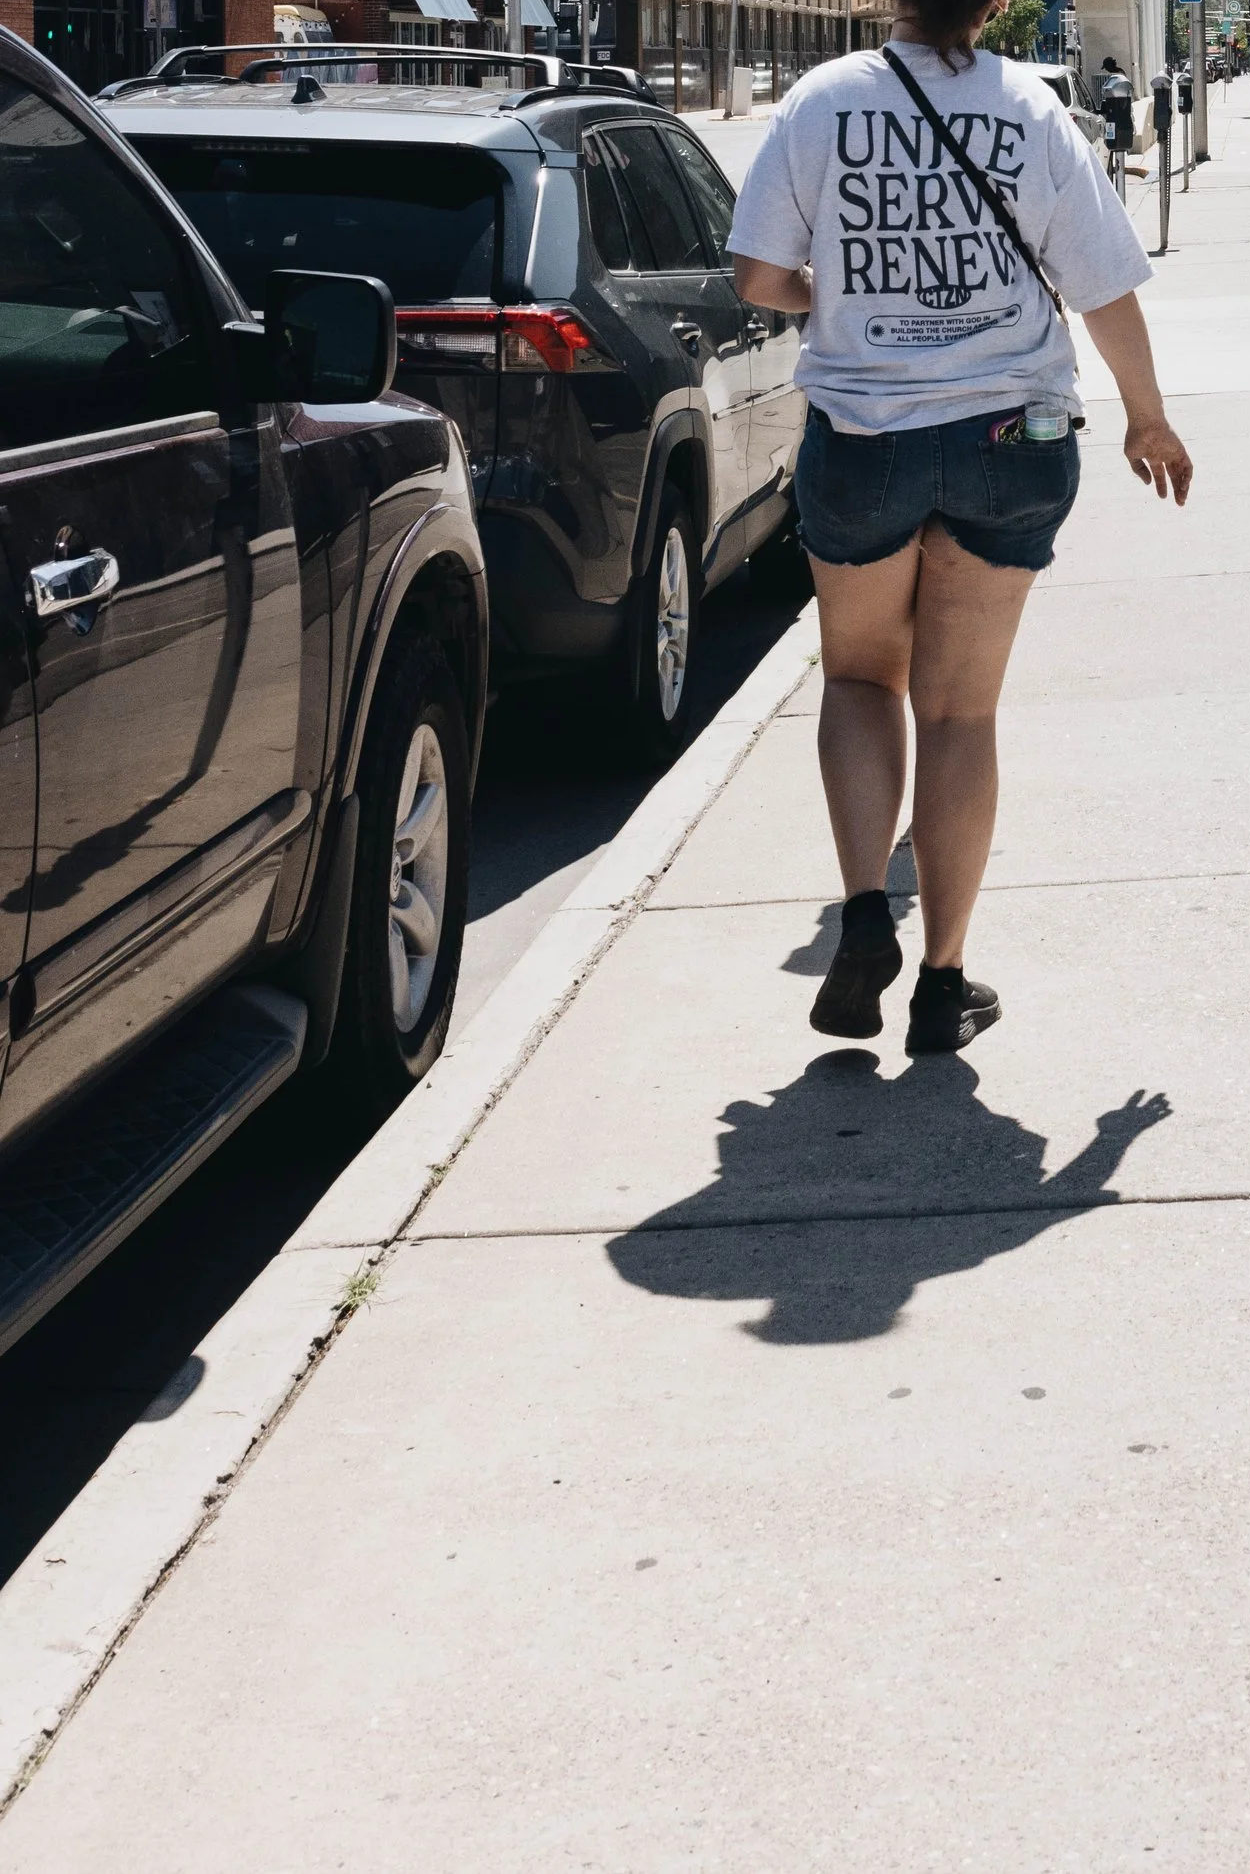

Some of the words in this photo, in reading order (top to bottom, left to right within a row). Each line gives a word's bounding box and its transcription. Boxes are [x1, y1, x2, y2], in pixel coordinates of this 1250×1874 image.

[836, 110, 1026, 179] UNITE
[919, 286, 970, 310] CTZN
[911, 318, 945, 327] PARTNER
[965, 316, 982, 324] GOD
[926, 326, 940, 334] THE
[941, 325, 972, 334] CHURCH
[911, 334, 943, 343] PEOPLE,
